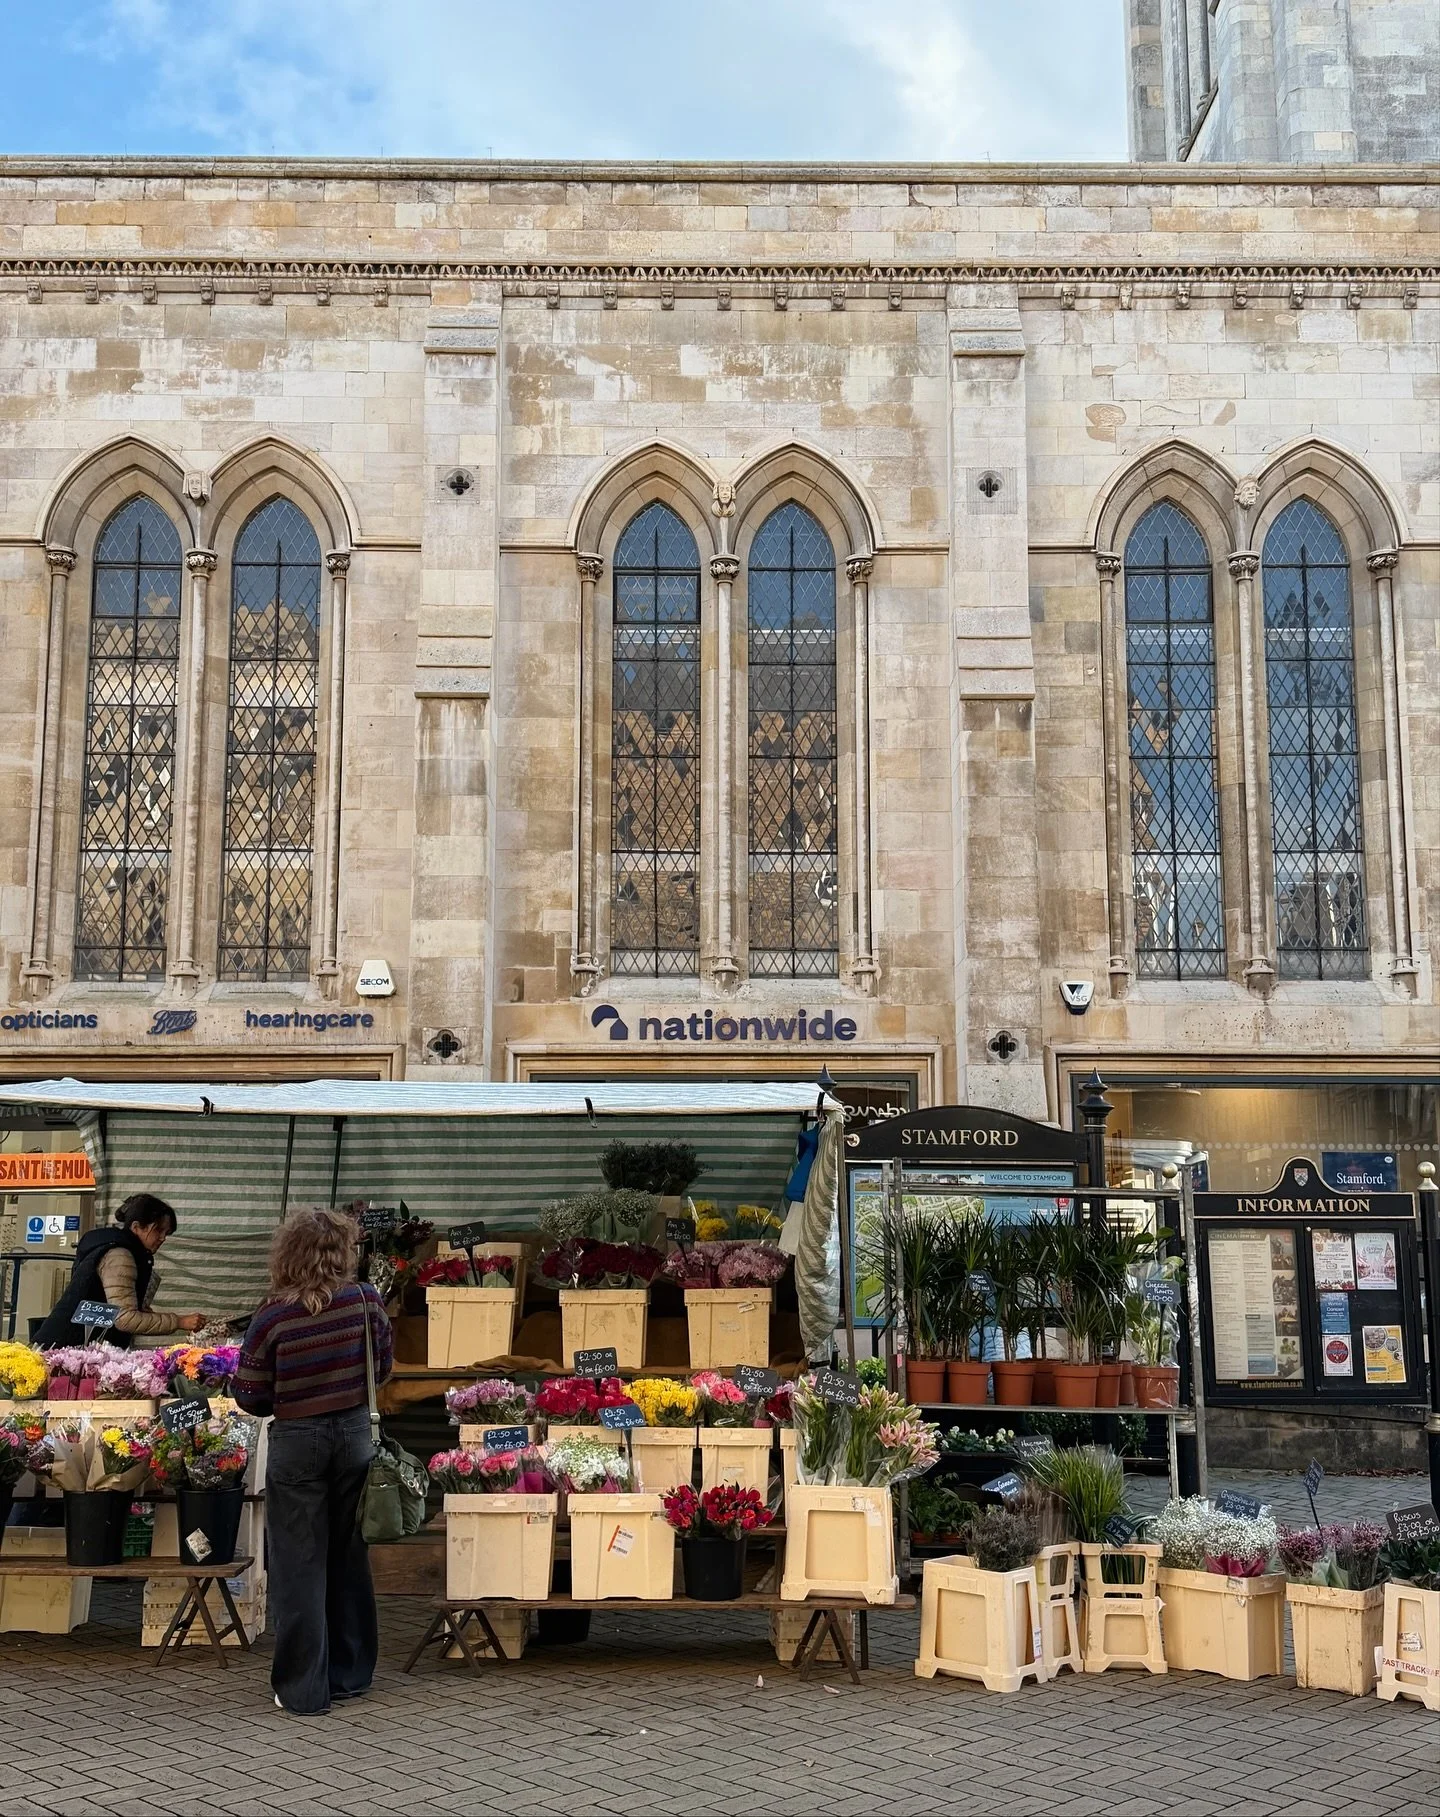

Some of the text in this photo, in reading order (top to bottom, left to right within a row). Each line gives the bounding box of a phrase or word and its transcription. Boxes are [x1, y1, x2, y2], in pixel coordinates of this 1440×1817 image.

[0, 1010, 98, 1031] opticians
[147, 1010, 197, 1034] Boots
[246, 1010, 374, 1032] hearingcare
[639, 1008, 858, 1041] nationwide
[902, 1129, 1019, 1146] STAMFORD
[1336, 1172, 1386, 1186] Stamford,
[1237, 1198, 1370, 1212] INFORMATION
[74, 1313, 84, 1322] 3
[576, 1366, 584, 1376] 3
[816, 1385, 822, 1394] 3
[1401, 1661, 1426, 1674] TRACK
